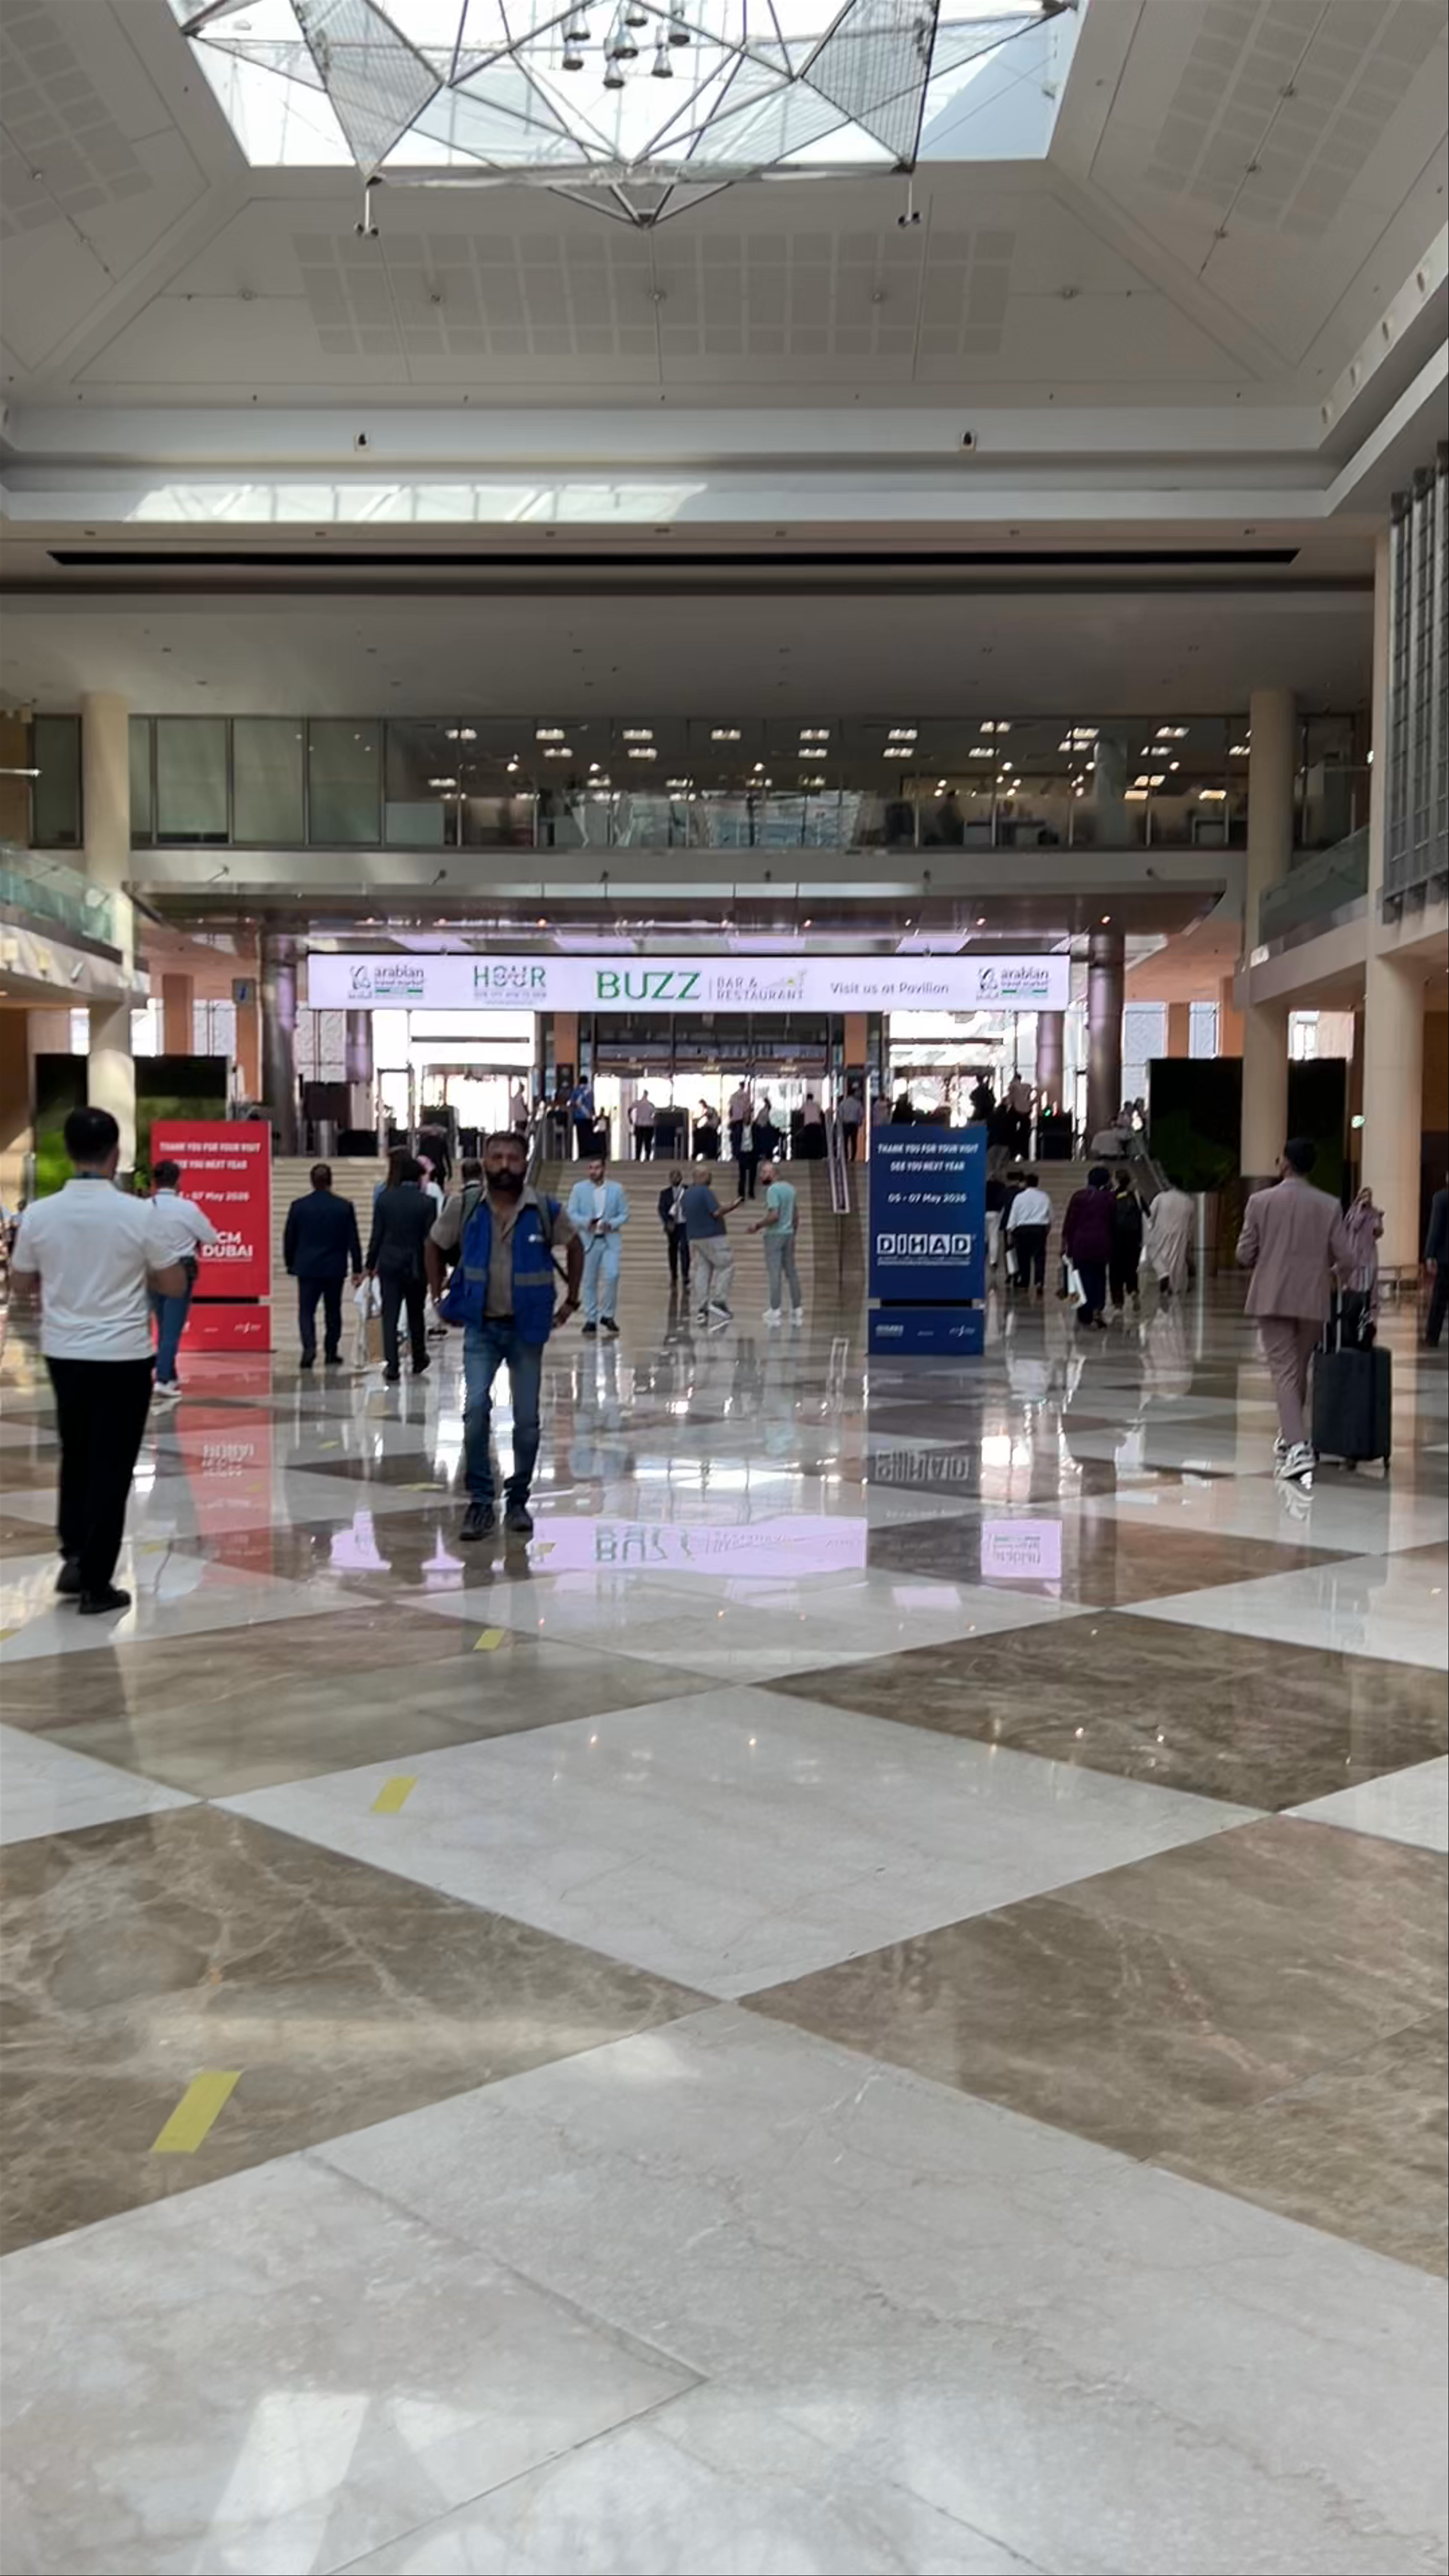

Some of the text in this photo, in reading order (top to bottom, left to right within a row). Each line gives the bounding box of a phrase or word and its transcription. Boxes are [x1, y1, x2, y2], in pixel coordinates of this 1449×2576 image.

[375, 965, 424, 978] arabian
[474, 965, 547, 987] HOUR
[1001, 967, 1049, 979] arabian
[596, 970, 701, 1000] BUZZ
[717, 977, 743, 988] BAR
[830, 982, 949, 995] Visit us at Pavilion
[717, 989, 804, 1000] RESTAURANT
[160, 1142, 186, 1153] THANK
[187, 1142, 202, 1153] YOU
[878, 1143, 979, 1154] THANK YOU FOR YOUR VISIT
[189, 1159, 204, 1169] YOU
[890, 1161, 965, 1172] SEE YOU NEXT YEAR
[908, 1193, 921, 1203] 07
[922, 1193, 943, 1204] May
[217, 1231, 242, 1244] CM
[877, 1233, 971, 1255] DIHAD
[202, 1245, 254, 1257] DUBAI
